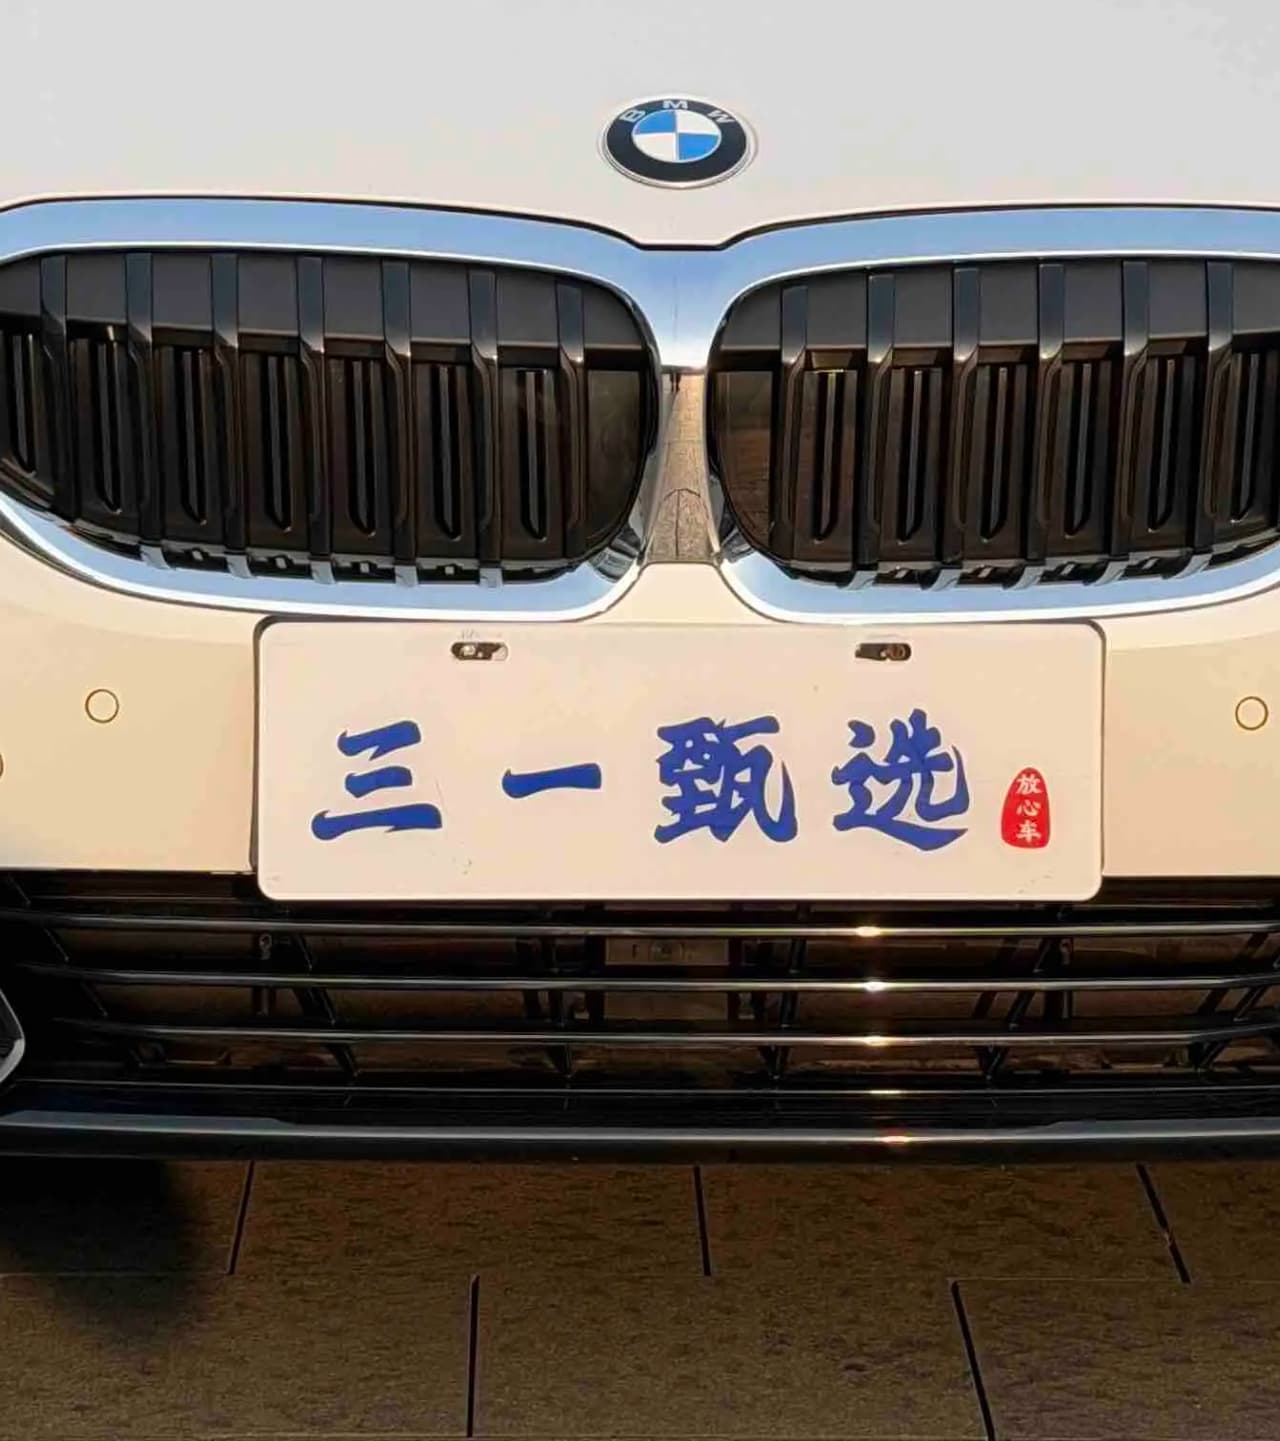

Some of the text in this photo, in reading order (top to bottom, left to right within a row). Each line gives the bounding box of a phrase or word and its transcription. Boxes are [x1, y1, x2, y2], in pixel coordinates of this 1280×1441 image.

[620, 100, 735, 123] BMW
[312, 709, 969, 851] 三一甄选
[1015, 773, 1043, 842] 放心车
